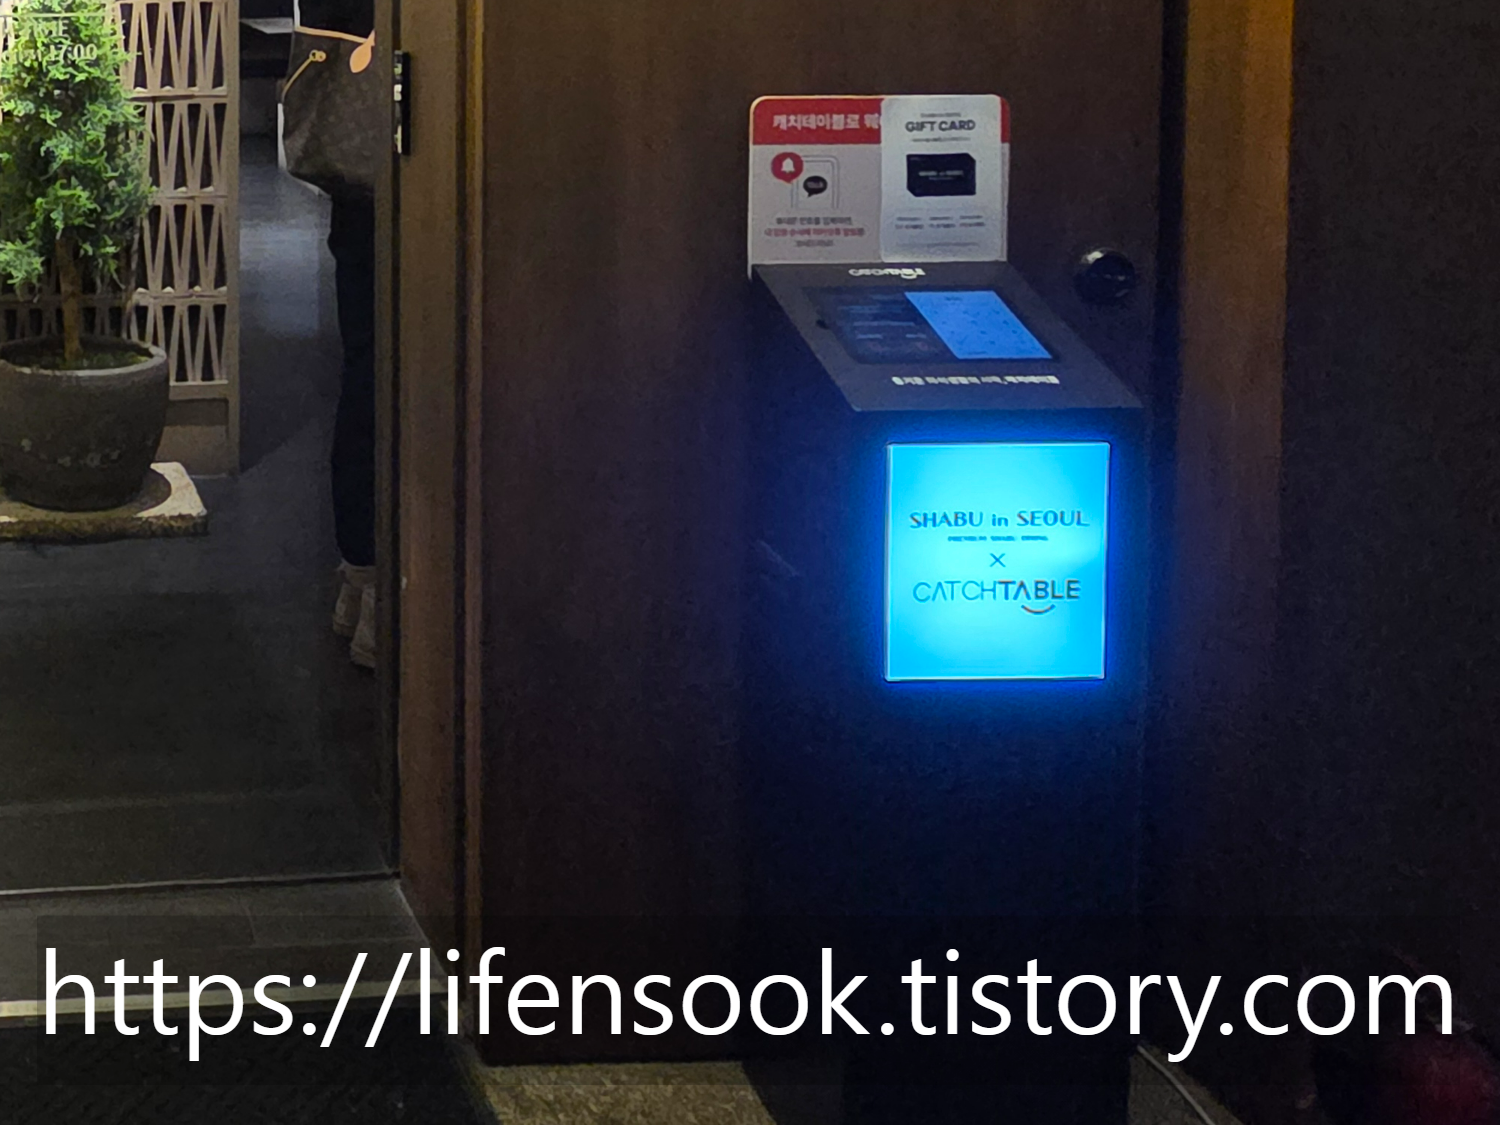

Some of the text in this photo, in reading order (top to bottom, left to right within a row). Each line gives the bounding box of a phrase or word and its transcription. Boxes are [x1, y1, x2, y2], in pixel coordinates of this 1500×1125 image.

[905, 119, 976, 133] GIFT CARD
[909, 510, 1091, 529] SHABU in SEOUL
[912, 579, 1082, 604] CATCHTABLE
